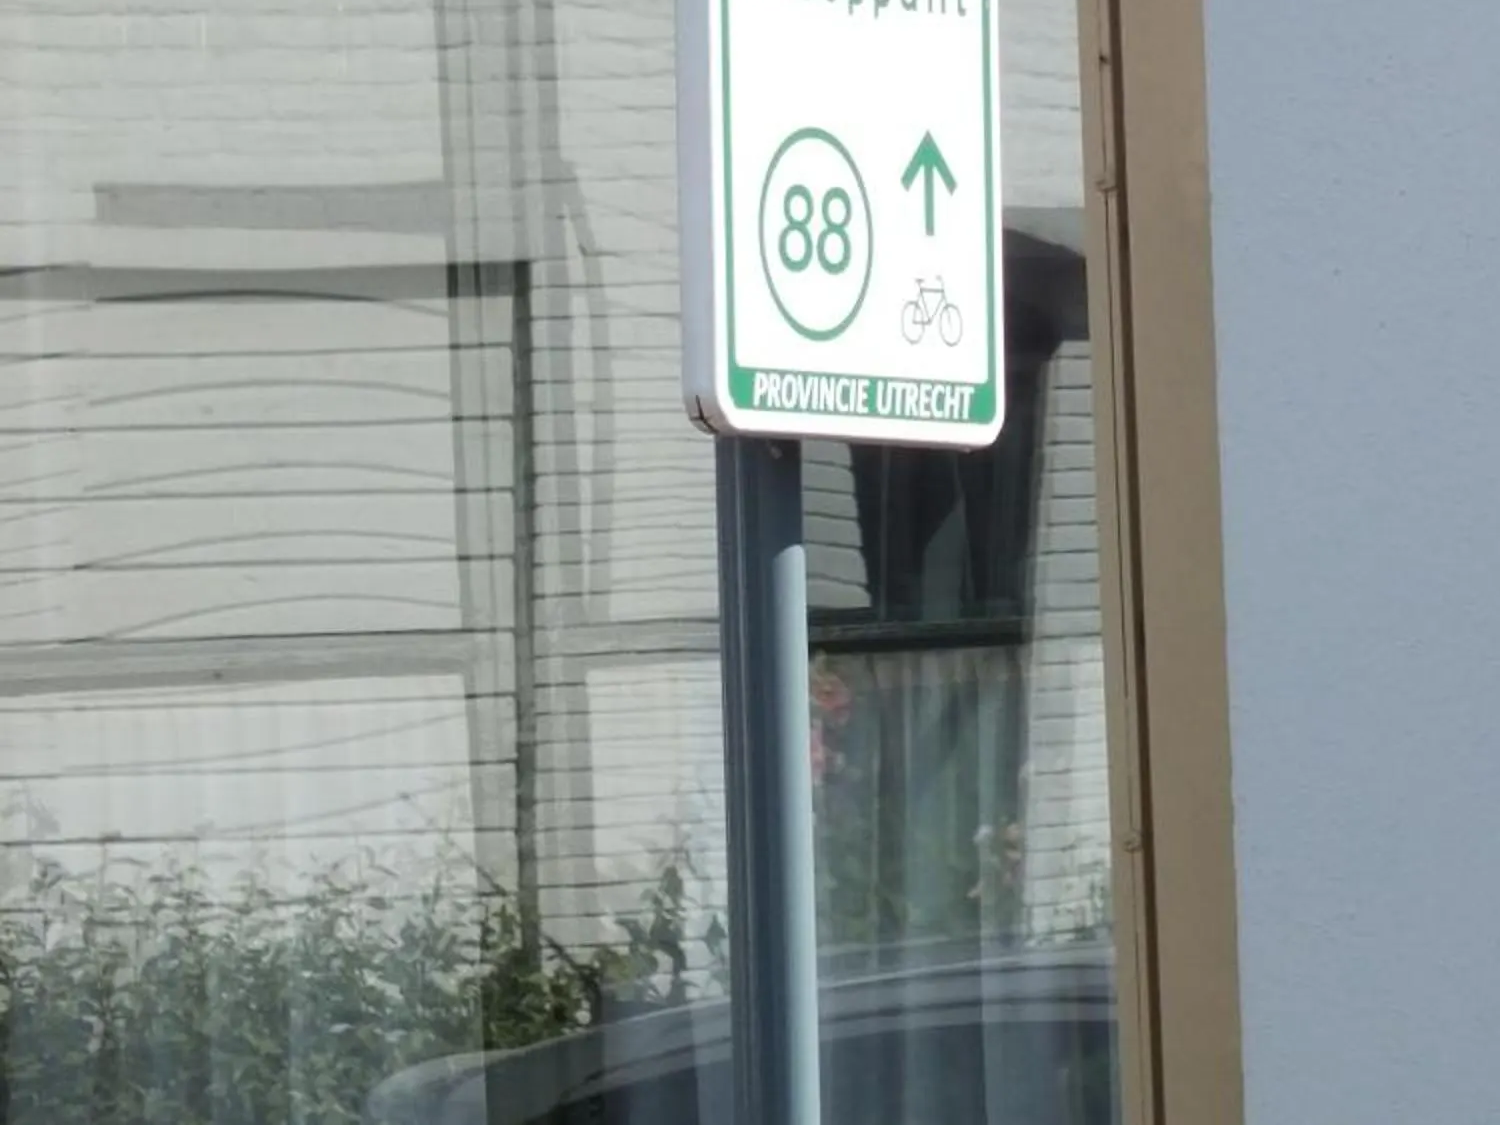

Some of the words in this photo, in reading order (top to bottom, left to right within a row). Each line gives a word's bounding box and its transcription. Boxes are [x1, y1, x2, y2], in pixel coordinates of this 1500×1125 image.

[778, 183, 852, 275] 88
[753, 371, 869, 413] PROVINCIE
[876, 379, 975, 421] UTRECHT
